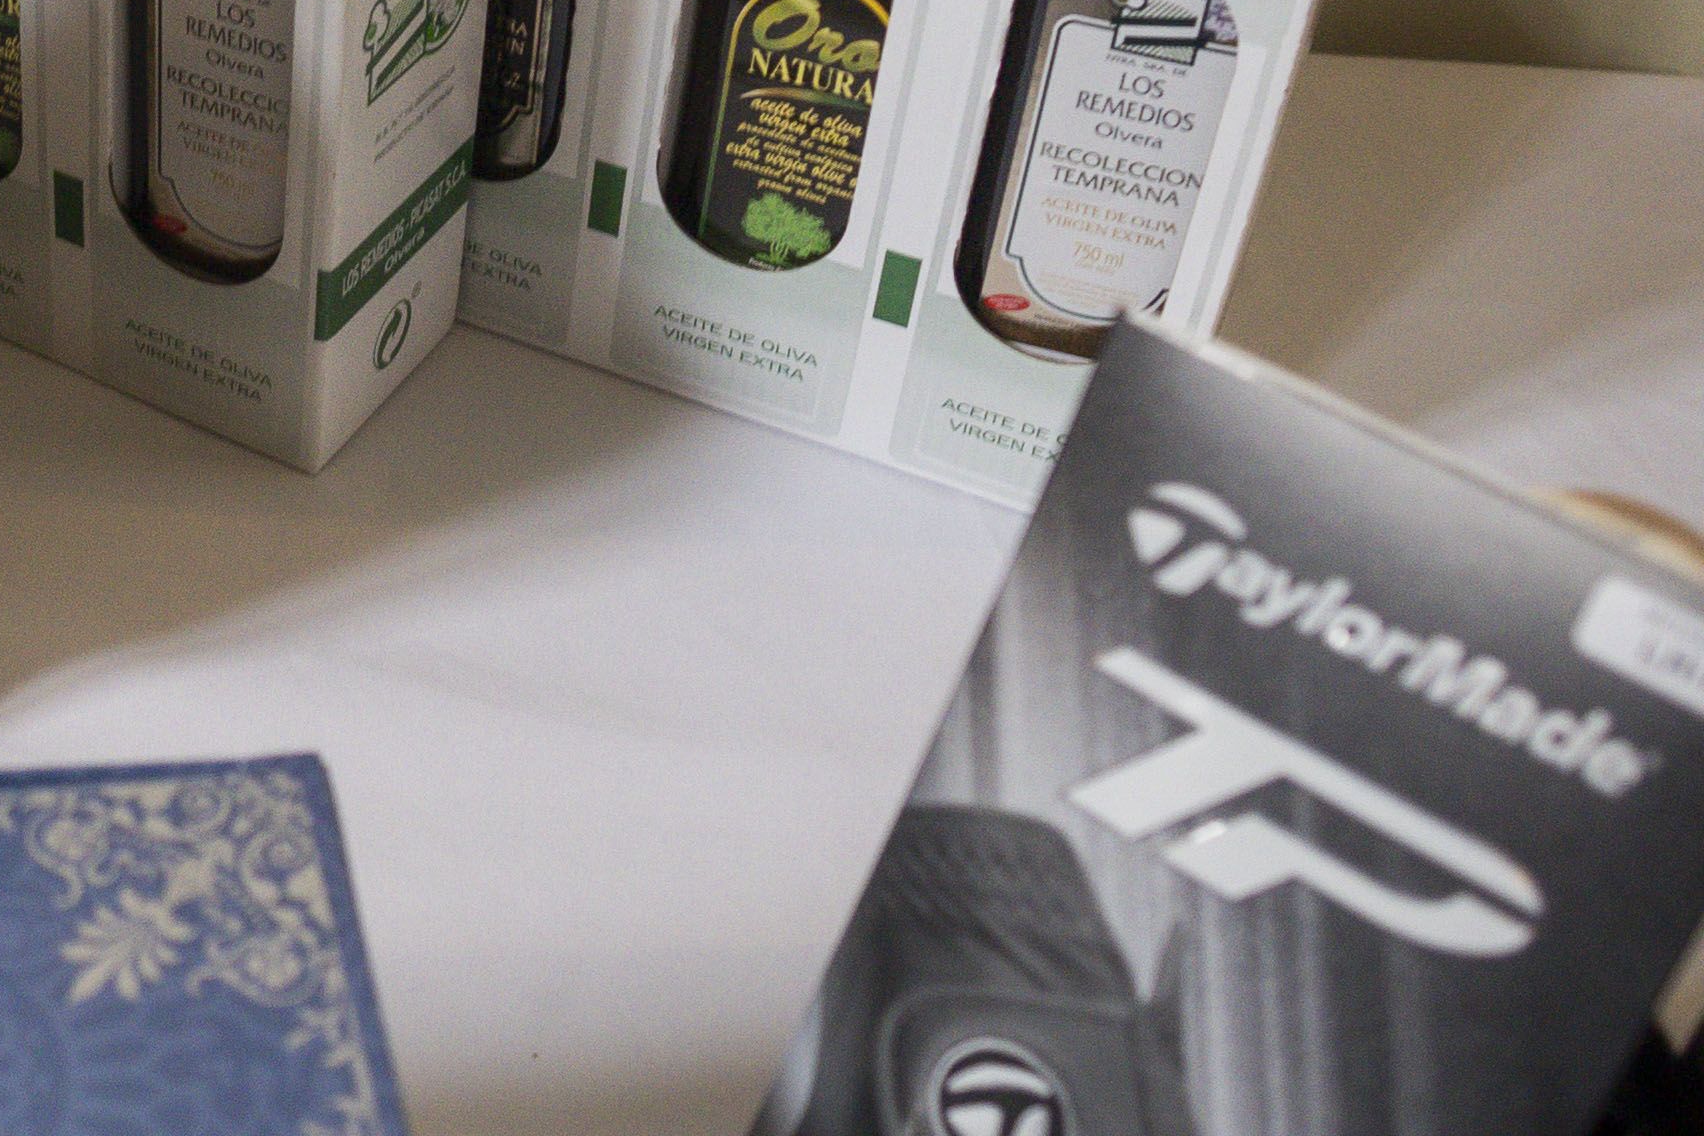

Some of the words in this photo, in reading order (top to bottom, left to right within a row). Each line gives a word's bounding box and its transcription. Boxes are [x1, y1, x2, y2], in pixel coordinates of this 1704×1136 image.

[185, 15, 287, 62] REMEDIOS
[1119, 73, 1167, 99] LOS
[750, 98, 796, 118] aceite
[800, 107, 819, 125] de
[823, 114, 863, 138] oliva
[759, 113, 806, 136] virgen
[811, 126, 849, 147] extra
[1075, 90, 1195, 132] REMEDIOS
[1095, 122, 1163, 149] Olvera
[1052, 165, 1179, 207] TEMPRANA
[1041, 197, 1099, 217] ACEITE
[1105, 210, 1126, 223] DE
[1131, 215, 1177, 236] OLIVA
[1045, 214, 1106, 237] VIRGEN
[1112, 228, 1166, 249] EXTRA
[654, 305, 723, 337] ACEITE
[728, 328, 755, 347] DE
[761, 338, 818, 367] OLIVA
[662, 325, 733, 358] VIRGEN
[739, 350, 804, 382] EXTRA
[941, 398, 1016, 430] ACEITE
[1021, 422, 1051, 441] DE
[949, 418, 1025, 452] VIRGEN
[1127, 482, 1648, 798] TaylorMade
